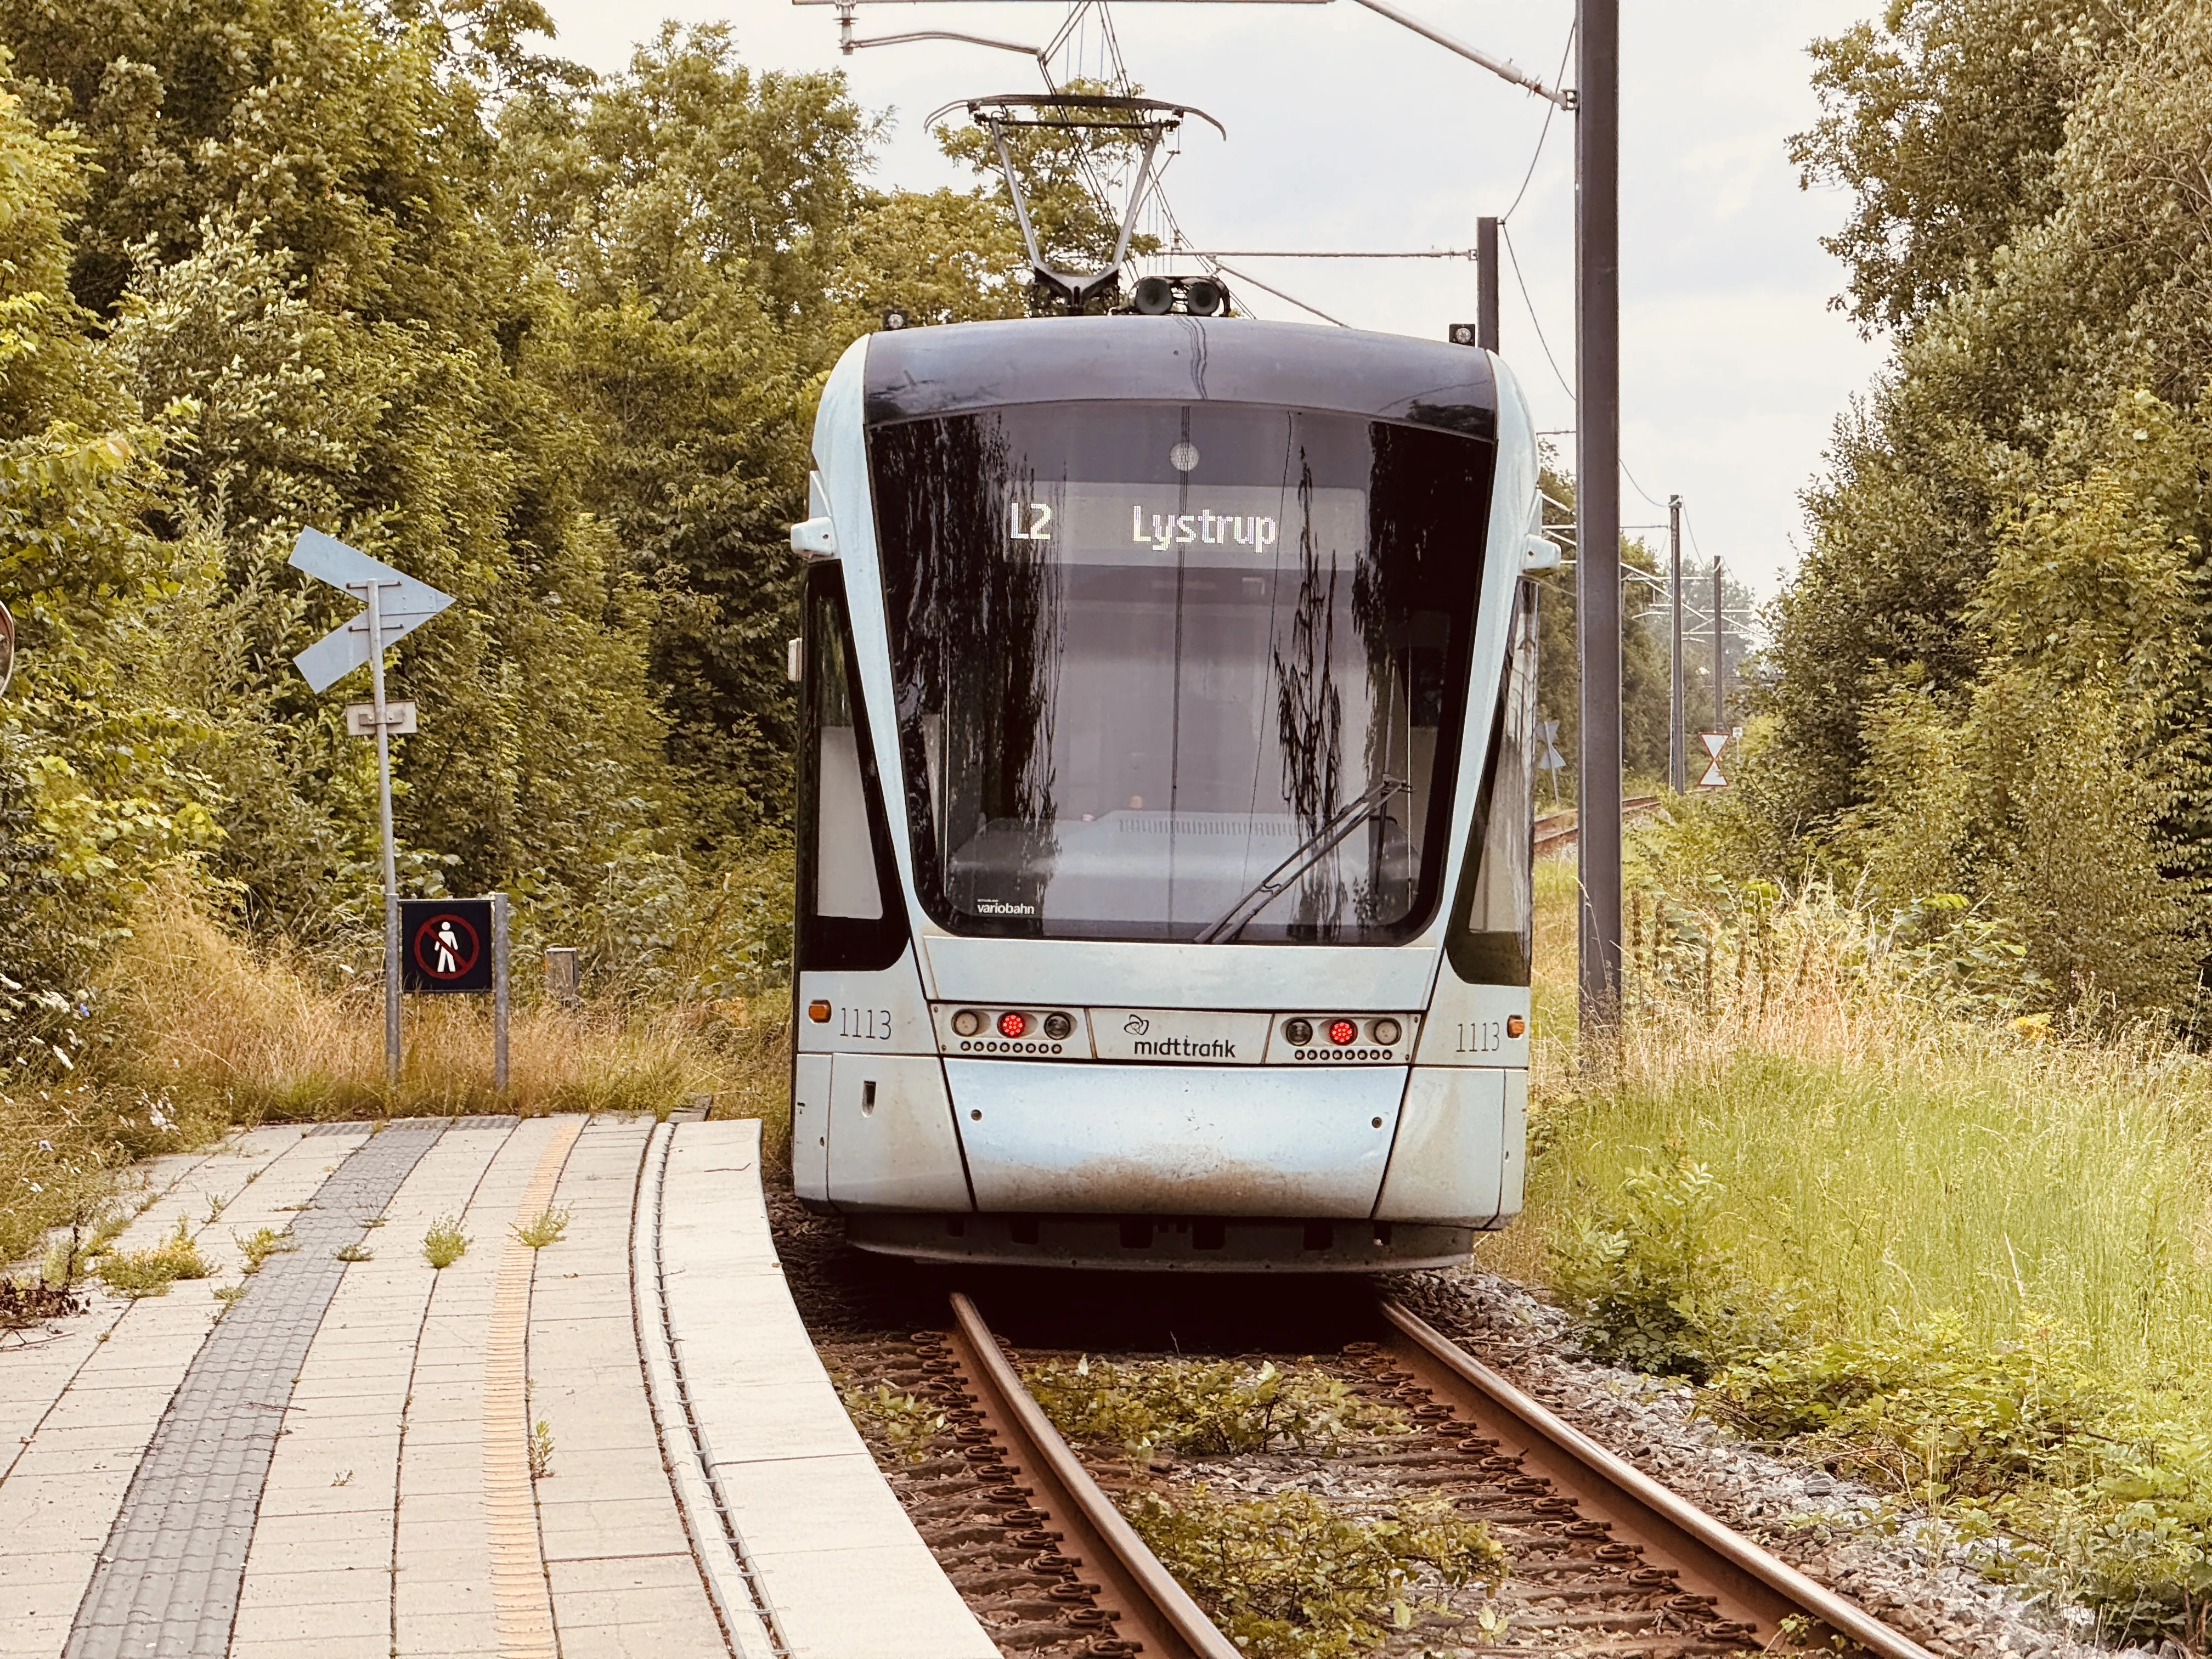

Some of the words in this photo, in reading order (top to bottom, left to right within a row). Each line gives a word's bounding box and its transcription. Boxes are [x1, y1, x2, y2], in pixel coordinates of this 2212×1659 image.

[1010, 502, 1052, 540] L2
[1132, 504, 1276, 554] Lystrup
[977, 902, 1035, 915] variobahn
[839, 1007, 892, 1040] 1113
[1455, 1022, 1500, 1053] 1113
[1134, 1035, 1236, 1058] midttrafik
